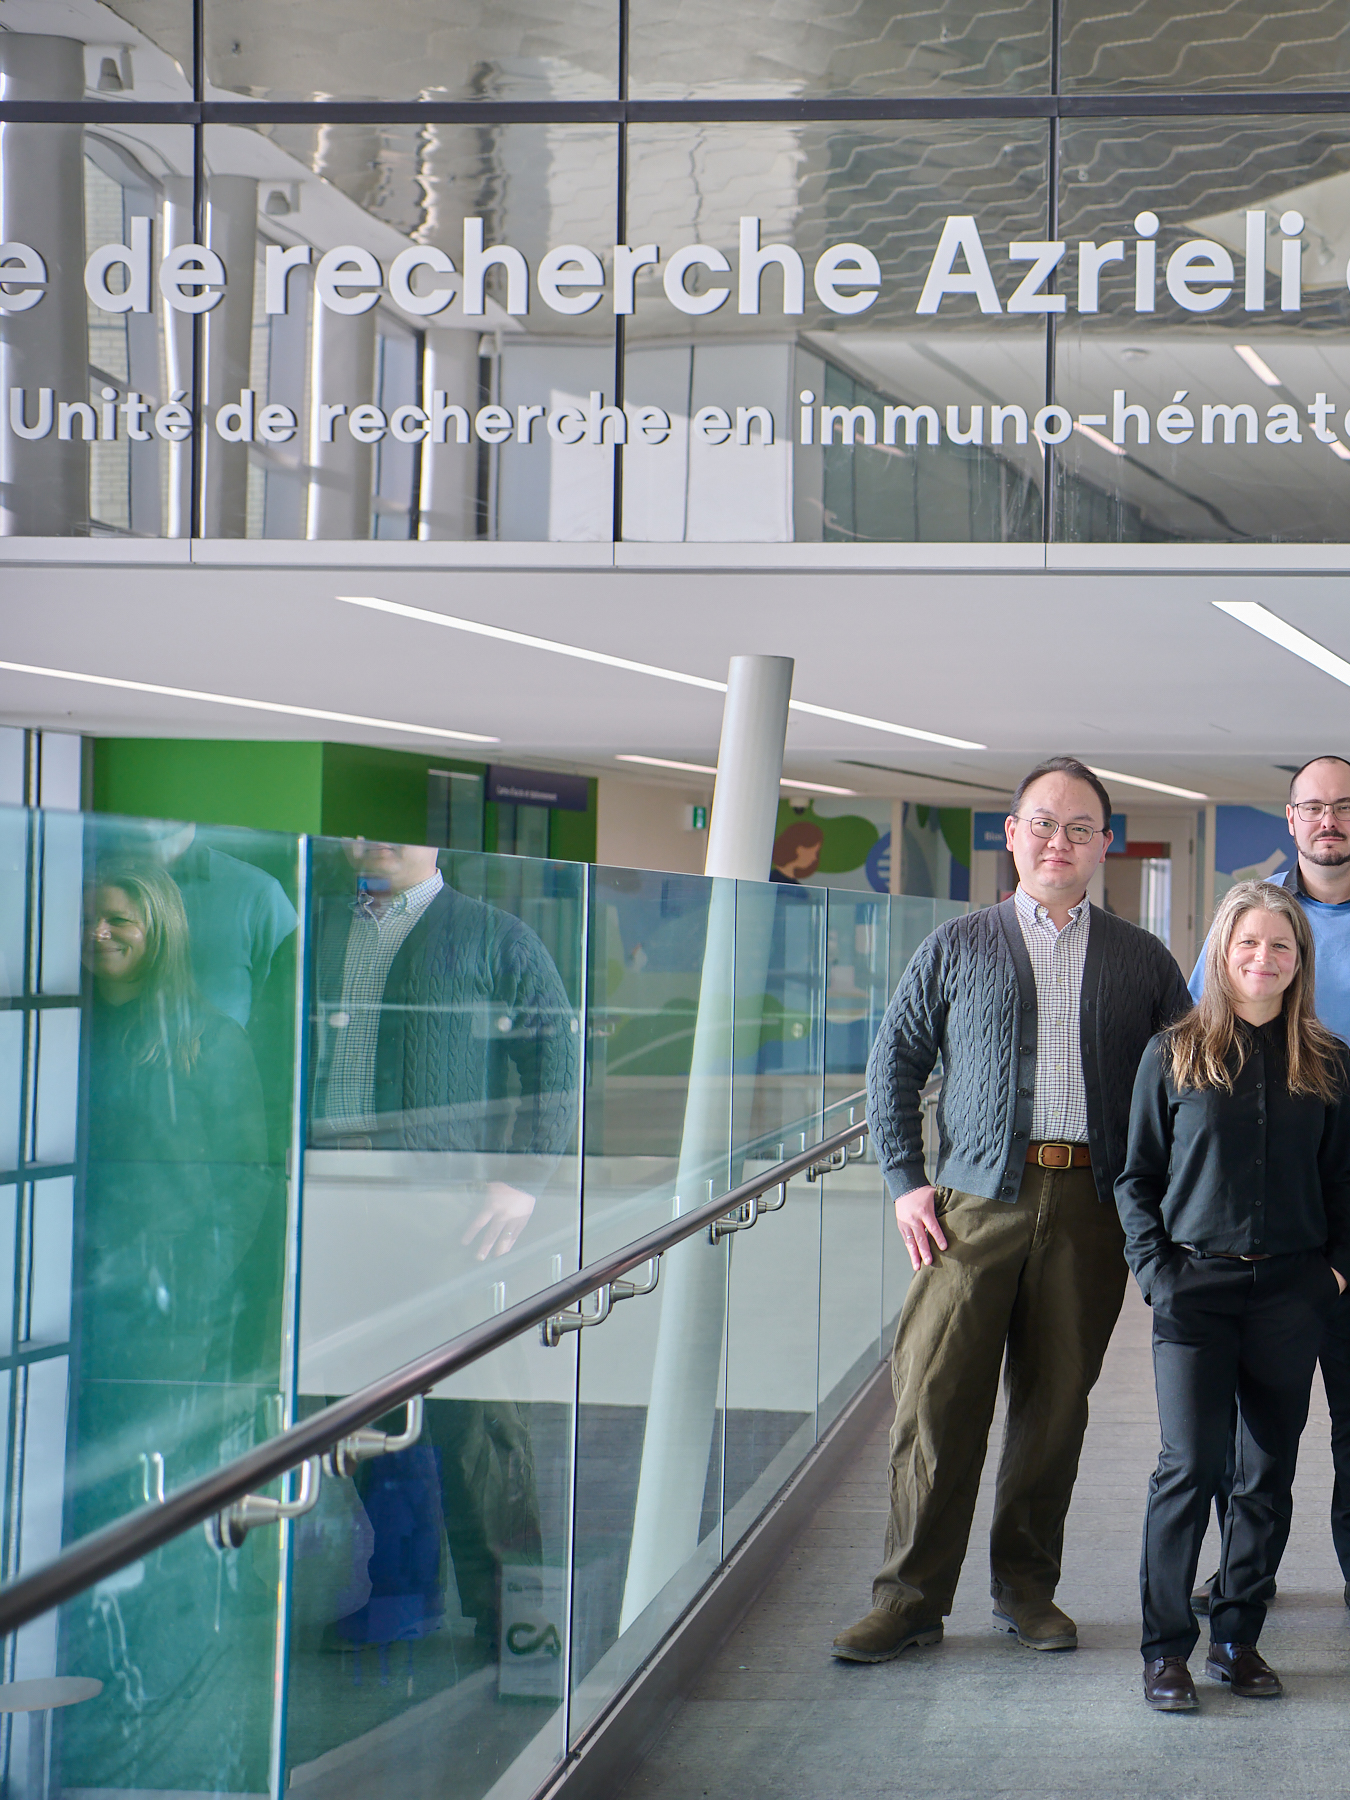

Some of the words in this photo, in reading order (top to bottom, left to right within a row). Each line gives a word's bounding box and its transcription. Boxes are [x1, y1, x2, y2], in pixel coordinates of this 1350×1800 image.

[85, 216, 226, 313] de
[266, 217, 882, 315] recherche
[916, 210, 1304, 314] Azrieli
[10, 387, 193, 442] Unité
[215, 389, 297, 443] de
[320, 390, 671, 445] recherche
[693, 405, 775, 445] en
